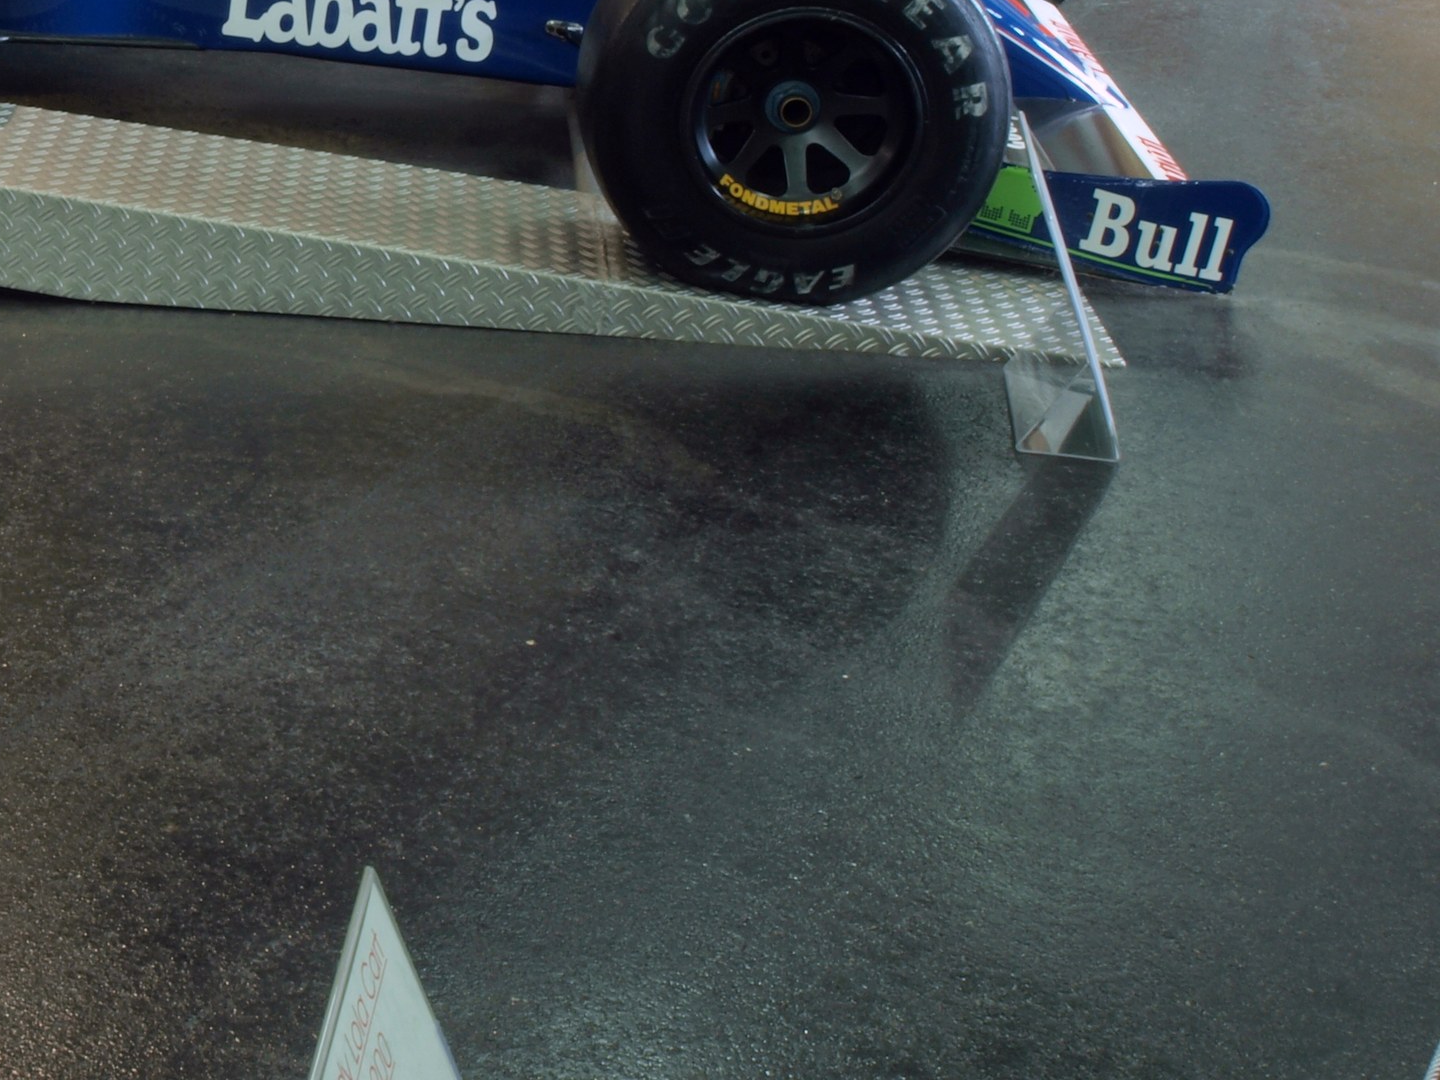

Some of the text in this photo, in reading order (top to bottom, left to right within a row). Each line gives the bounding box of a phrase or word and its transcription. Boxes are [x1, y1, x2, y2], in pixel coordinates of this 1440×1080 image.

[719, 173, 841, 217] FONDMETAL
[1078, 187, 1233, 283] Bull
[684, 244, 856, 295] EAGLE
